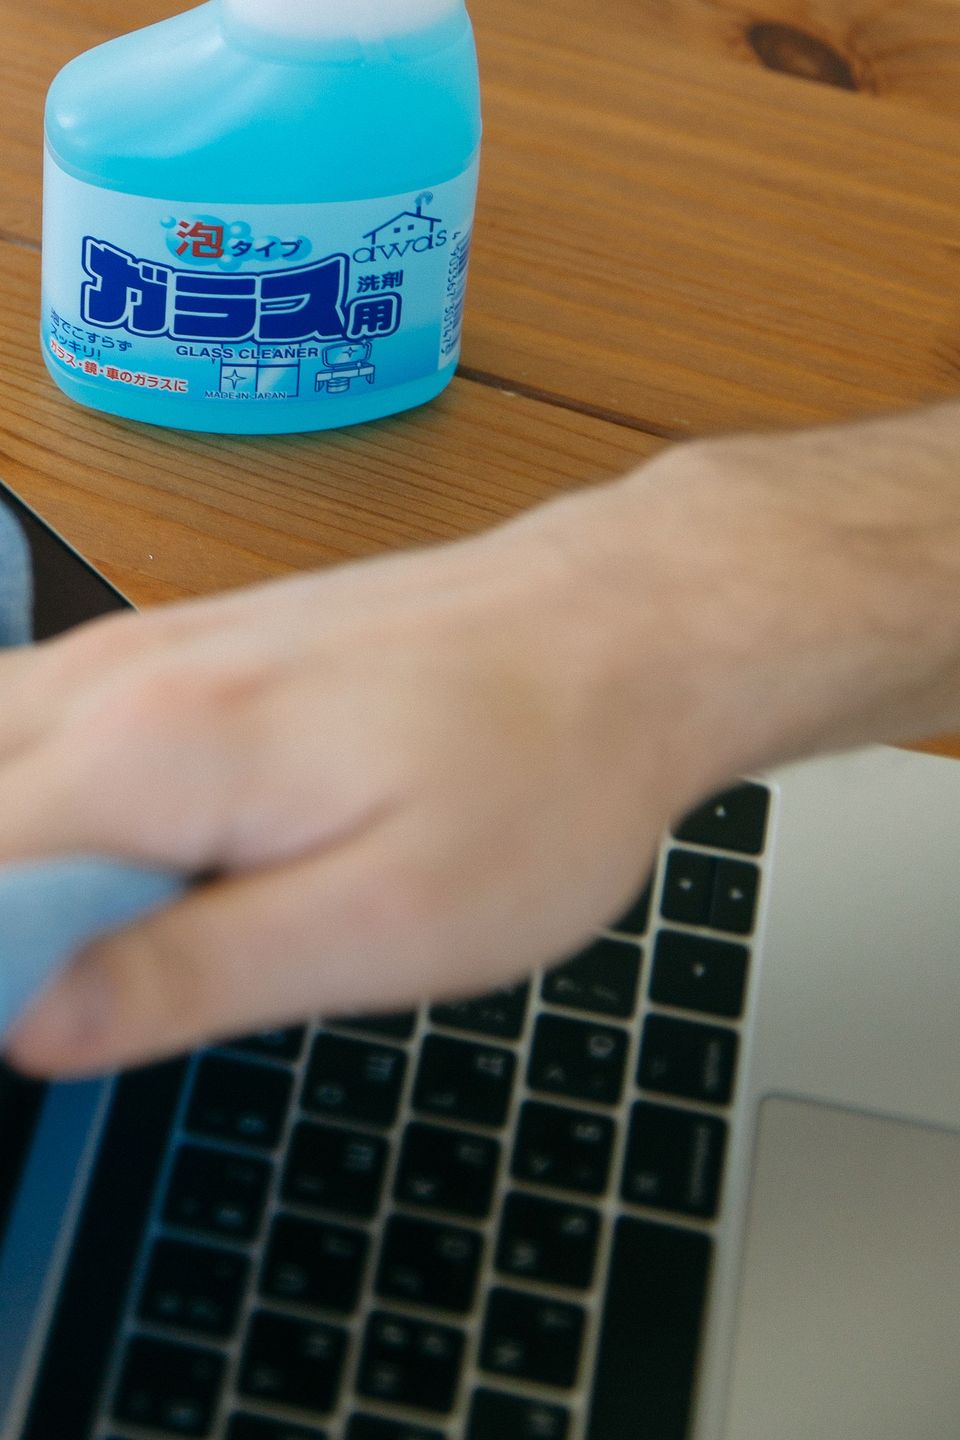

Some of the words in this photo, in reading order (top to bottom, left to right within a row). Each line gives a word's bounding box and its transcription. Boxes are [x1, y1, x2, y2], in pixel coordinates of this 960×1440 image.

[353, 229, 447, 263] awas
[357, 269, 403, 293] 洗剤
[176, 345, 233, 359] GLASS
[239, 346, 318, 359] CLEANER
